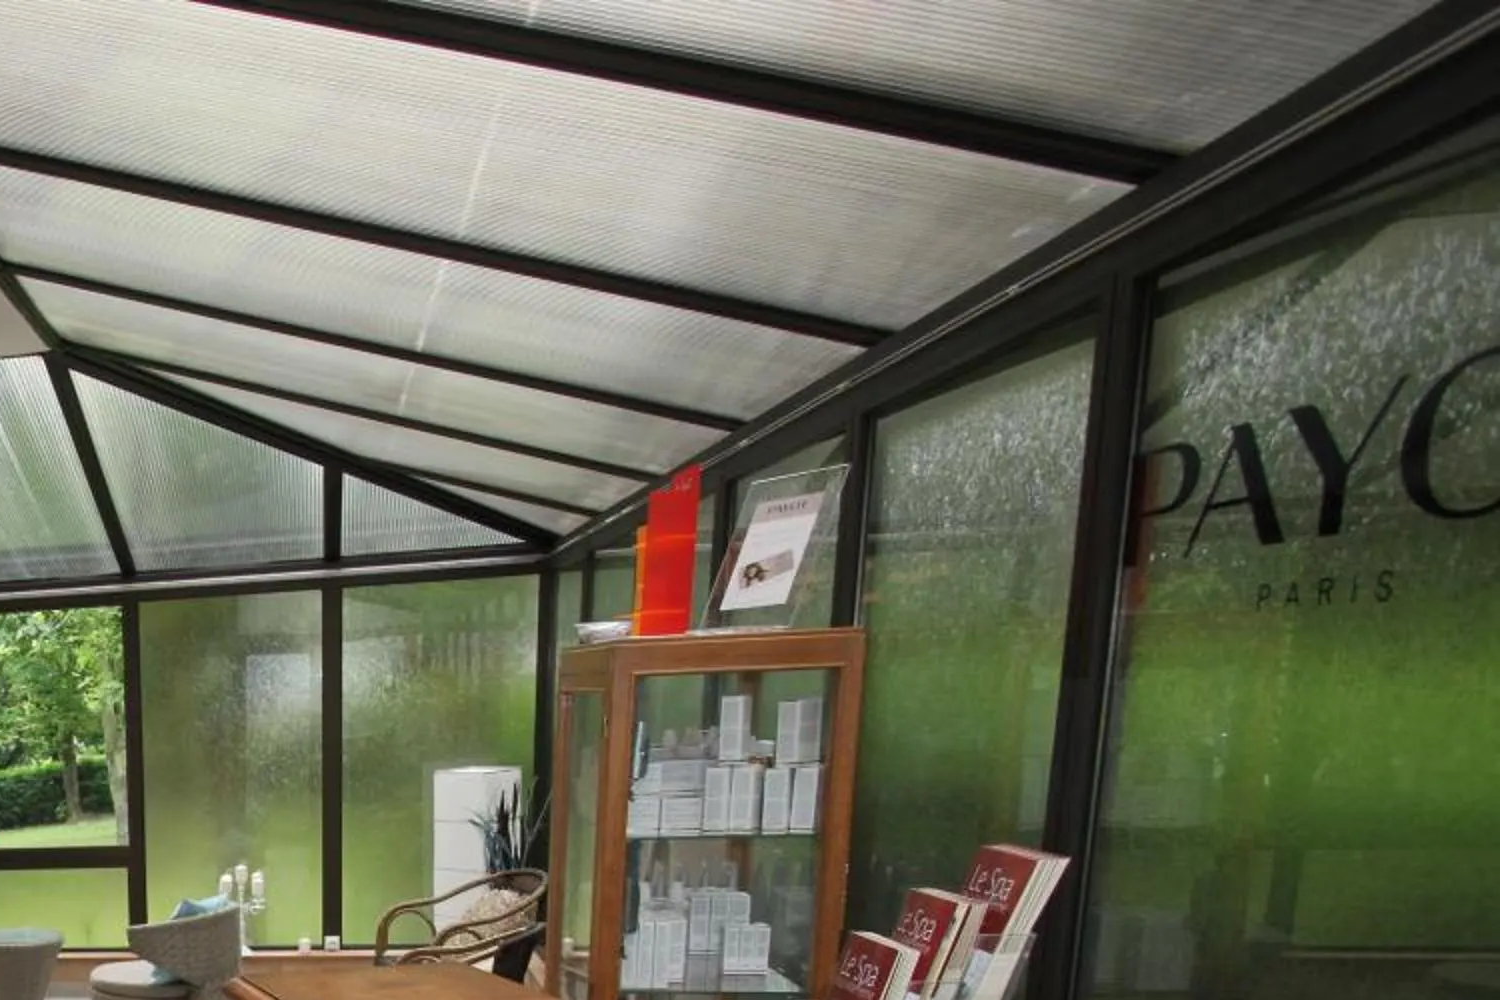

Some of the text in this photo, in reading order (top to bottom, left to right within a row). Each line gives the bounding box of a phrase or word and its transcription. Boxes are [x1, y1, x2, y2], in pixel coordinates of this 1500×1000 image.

[1255, 568, 1395, 612] PARIS
[968, 863, 988, 893] Le
[984, 867, 1015, 903] Spa
[908, 908, 937, 942] Spa
[839, 949, 879, 988] Le Spa
